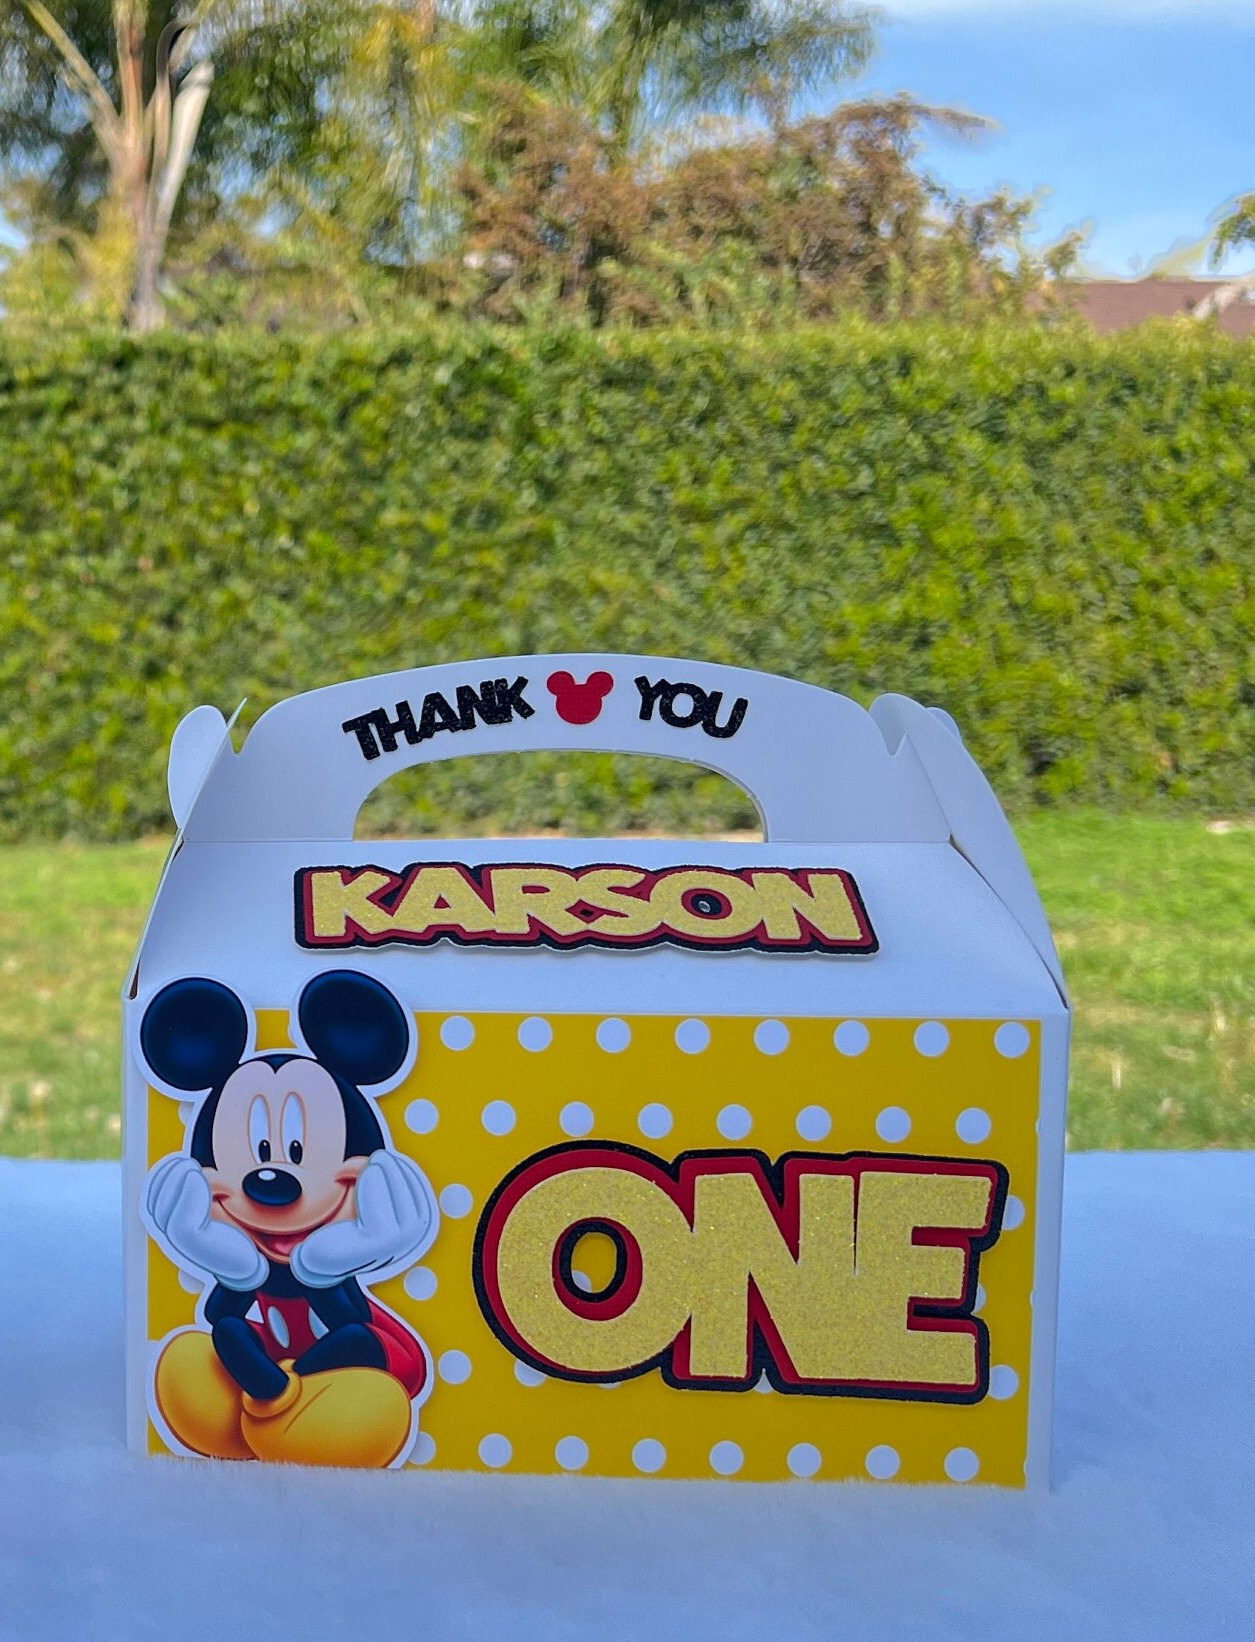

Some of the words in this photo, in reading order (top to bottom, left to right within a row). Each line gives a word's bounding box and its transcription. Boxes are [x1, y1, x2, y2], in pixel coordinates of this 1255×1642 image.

[342, 675, 535, 761] THANK
[633, 675, 748, 740] YOU
[311, 867, 863, 941] KARSON
[497, 1166, 996, 1386] ONE
